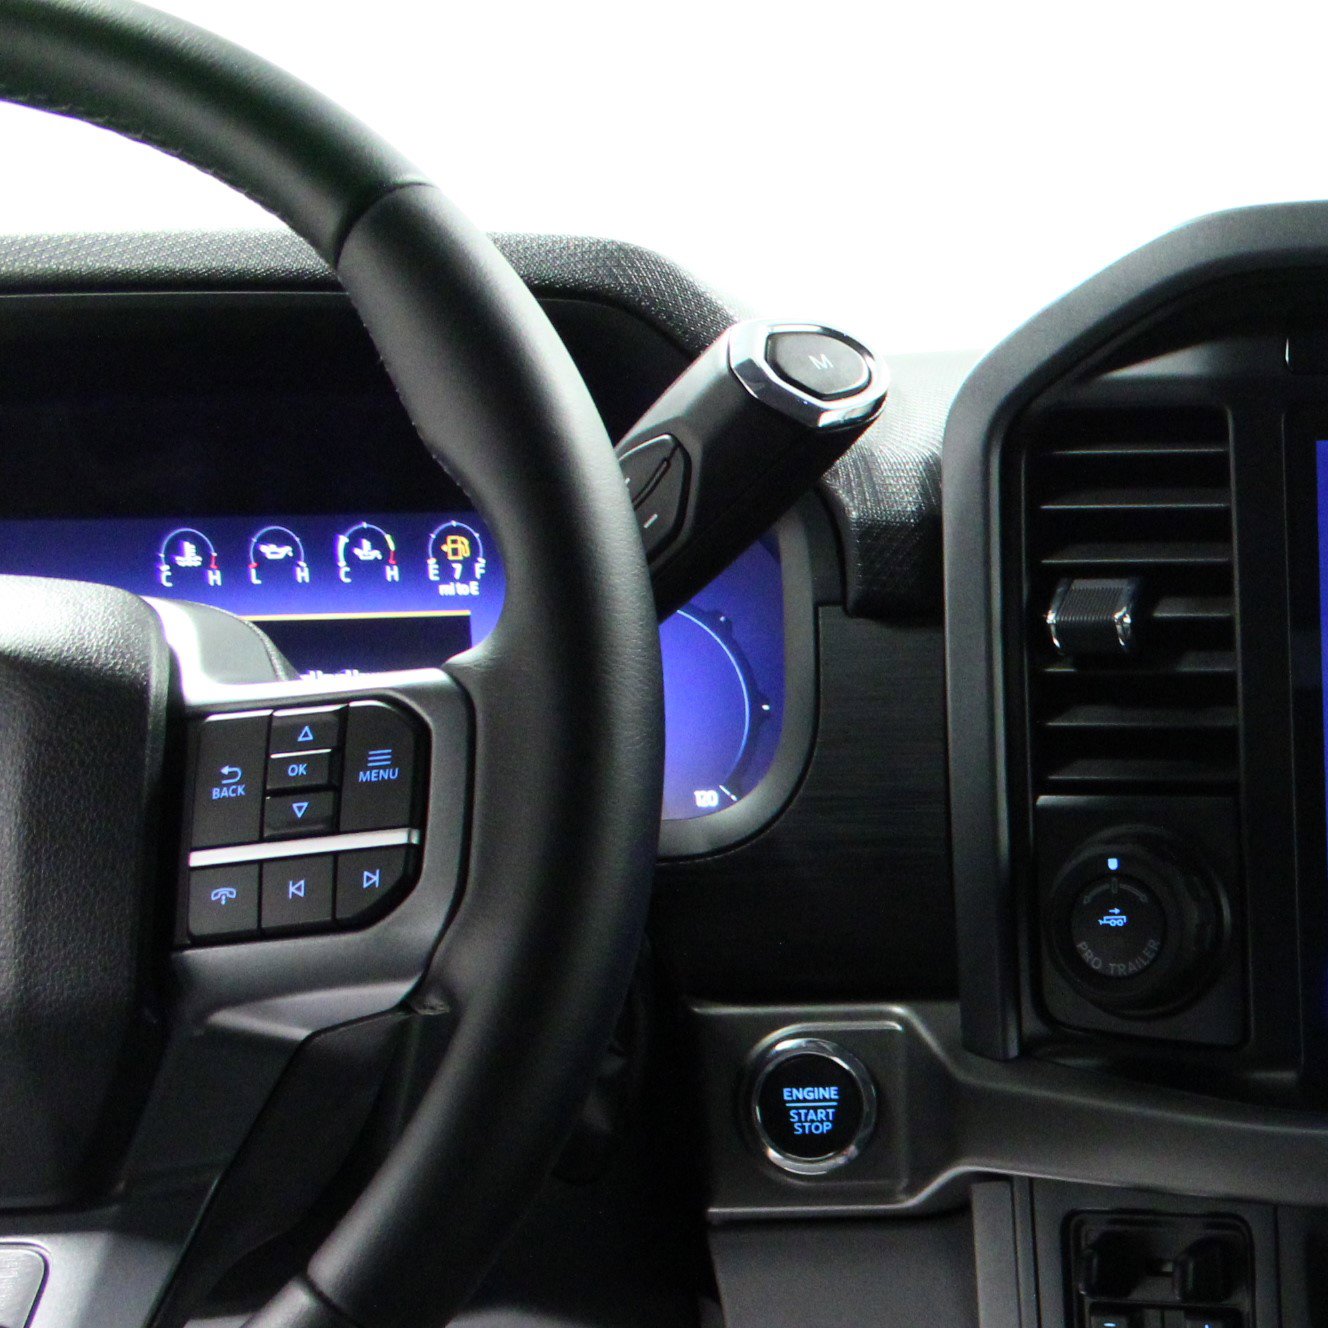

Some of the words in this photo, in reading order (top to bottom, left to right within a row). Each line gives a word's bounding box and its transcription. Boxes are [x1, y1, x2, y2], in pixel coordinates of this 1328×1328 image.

[808, 354, 833, 369] M
[208, 570, 221, 586] H
[251, 569, 262, 585] L
[297, 567, 310, 583] H
[386, 565, 399, 582] H
[429, 565, 440, 581] E
[452, 563, 463, 579] 7
[474, 564, 486, 579] F
[469, 582, 480, 596] E
[287, 763, 308, 777] OK
[357, 766, 399, 783] MENU
[211, 783, 246, 799] BACK
[1076, 941, 1103, 970] PRO
[782, 1085, 840, 1102] ENGINE
[788, 1107, 836, 1122] START
[792, 1121, 833, 1136] STOP
